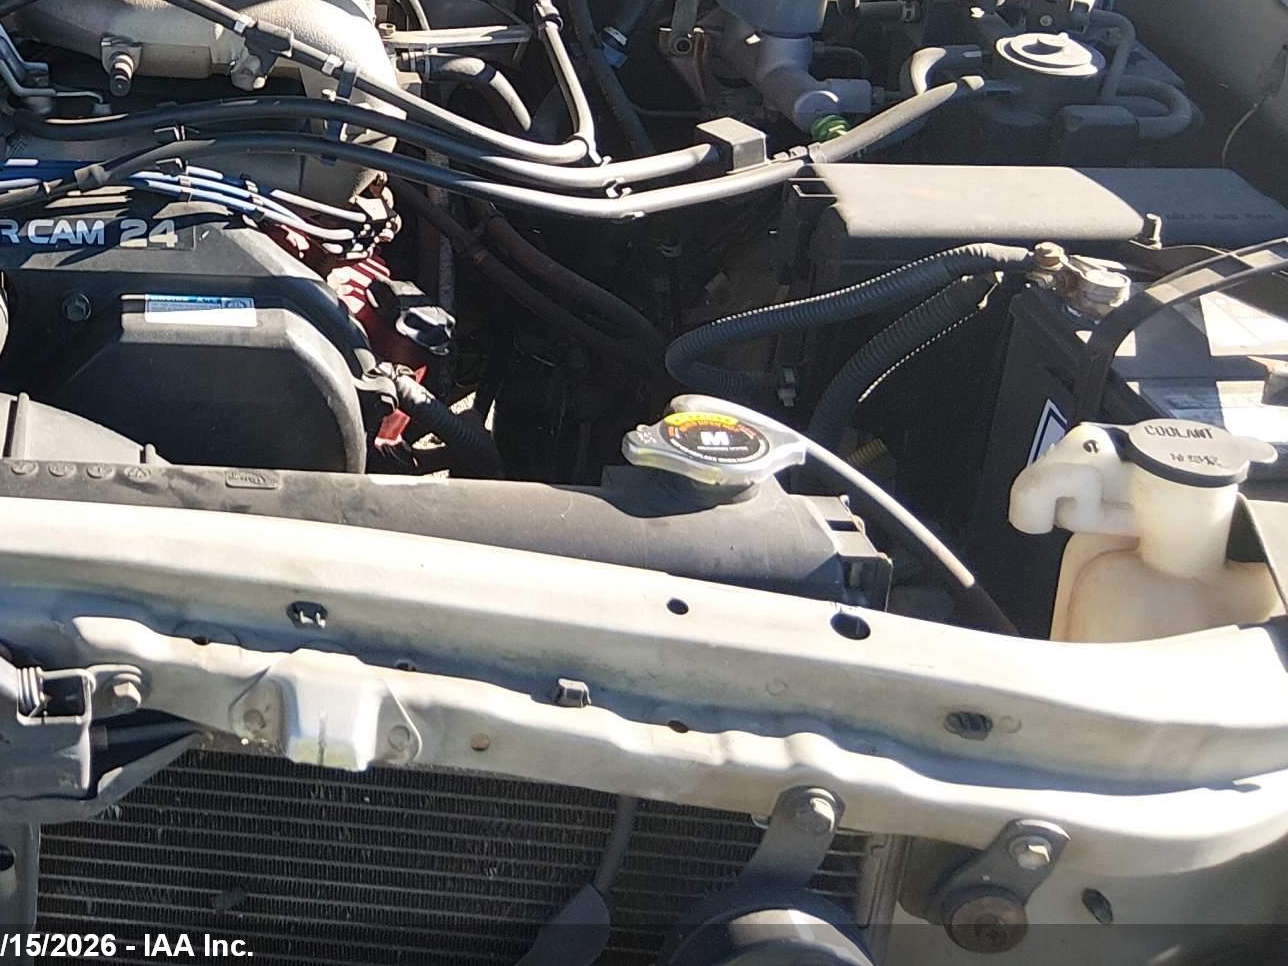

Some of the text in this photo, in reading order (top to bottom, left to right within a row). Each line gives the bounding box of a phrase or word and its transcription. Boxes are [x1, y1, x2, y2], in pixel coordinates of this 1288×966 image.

[27, 219, 104, 245] CAM
[119, 219, 178, 248] 24
[1144, 425, 1214, 440] COOLANT
